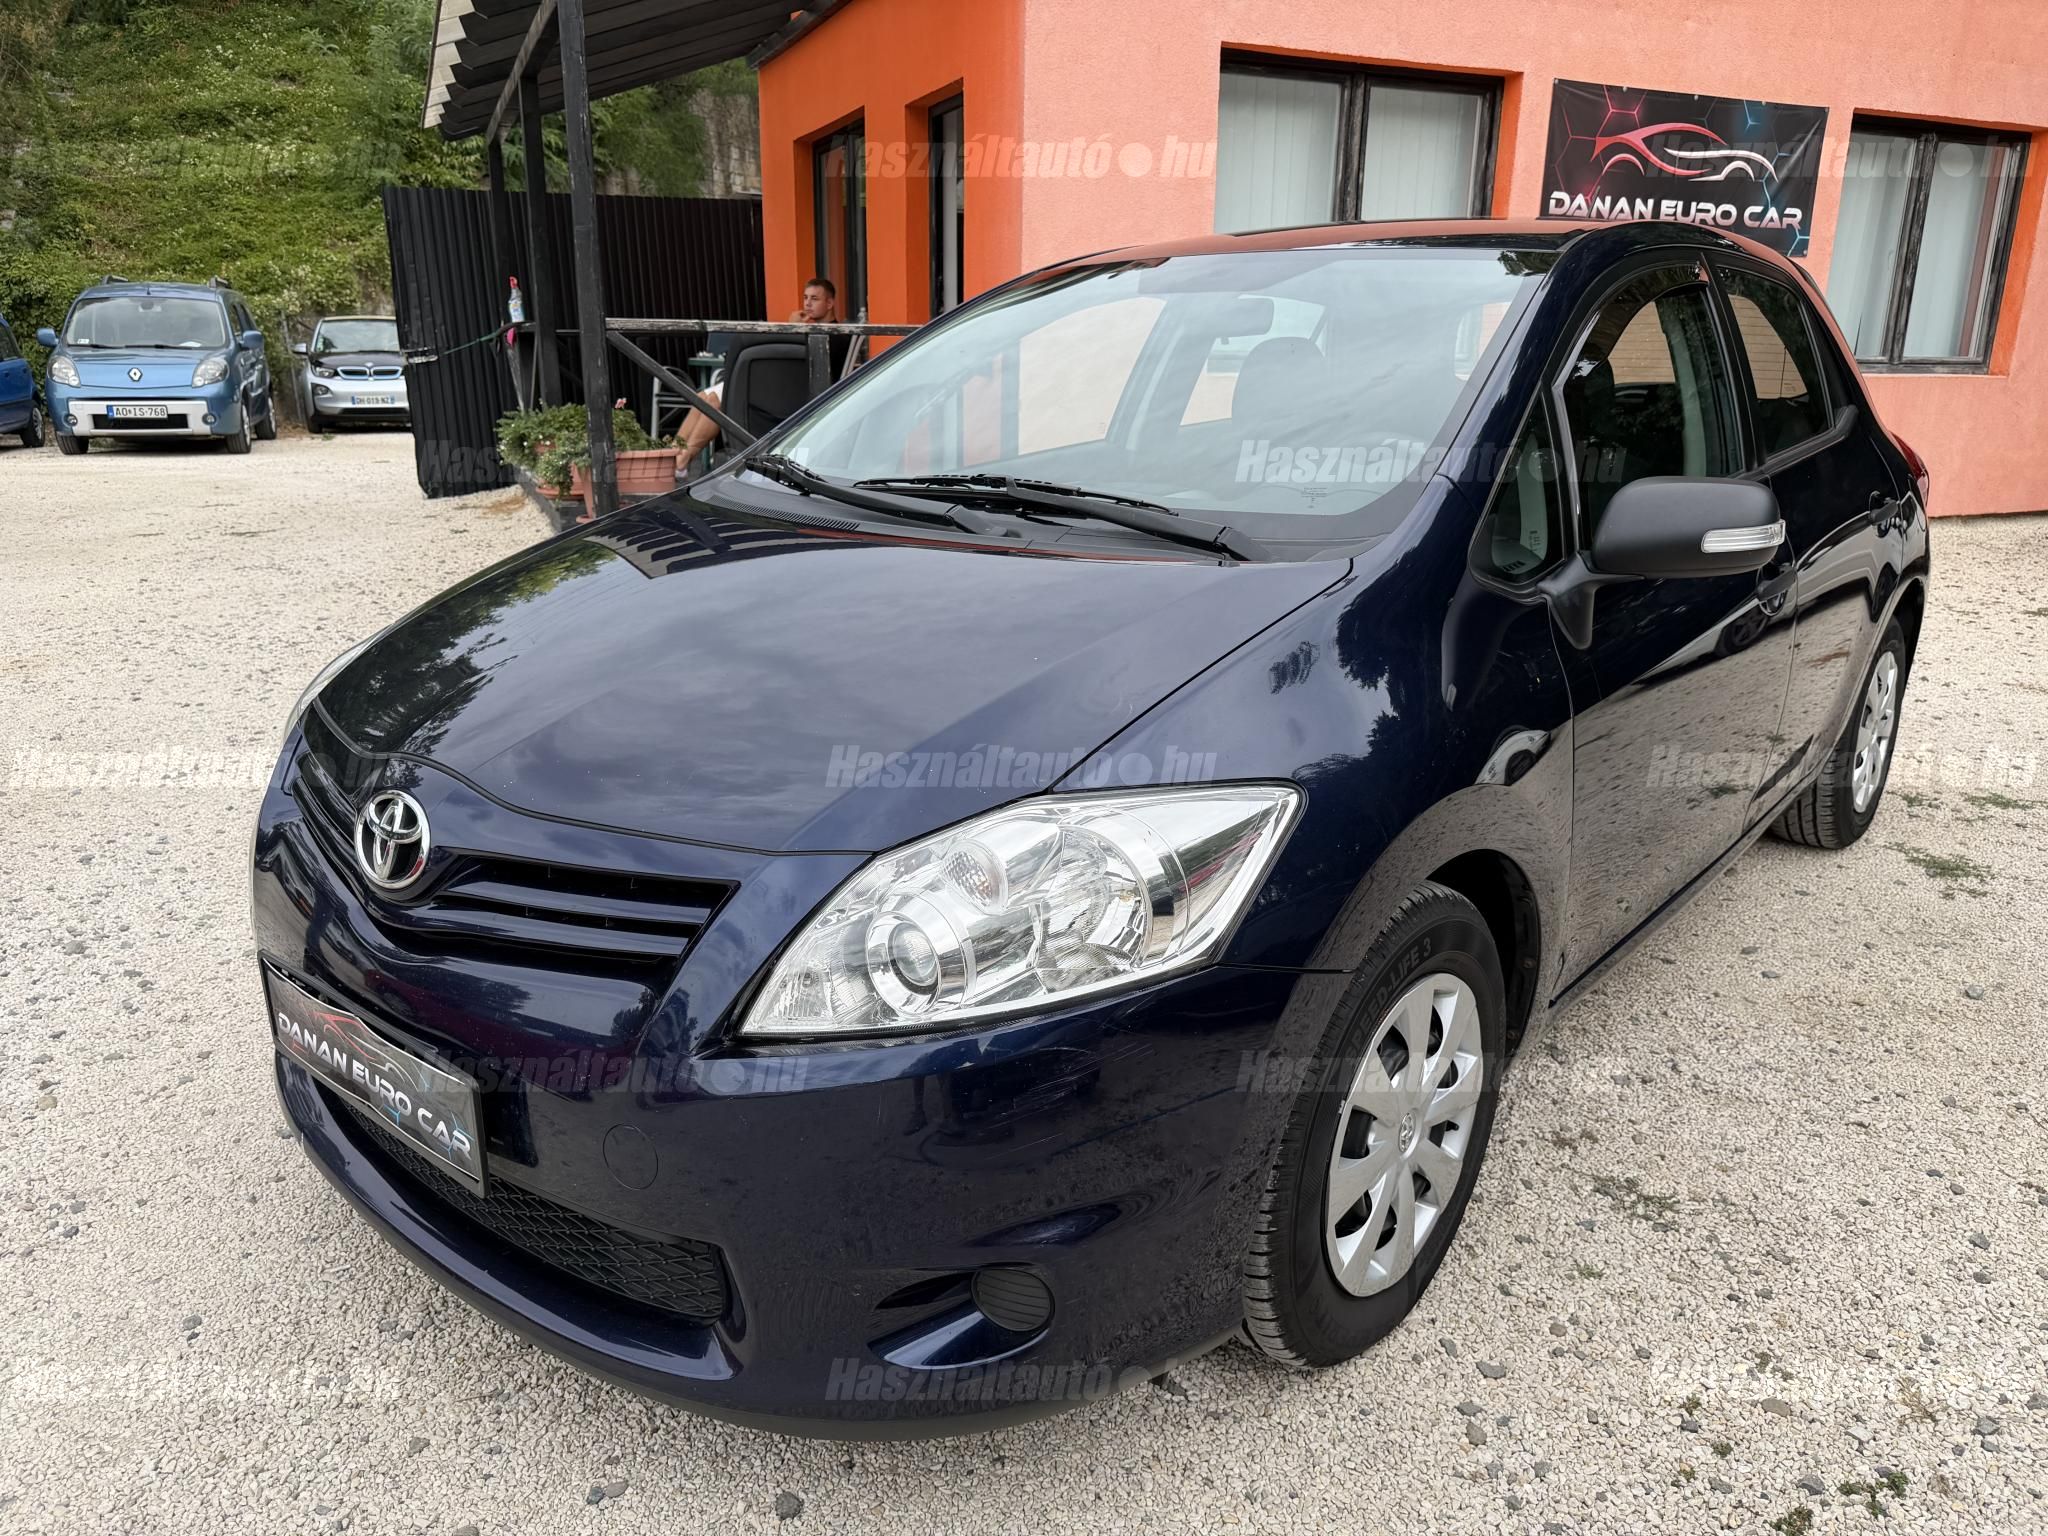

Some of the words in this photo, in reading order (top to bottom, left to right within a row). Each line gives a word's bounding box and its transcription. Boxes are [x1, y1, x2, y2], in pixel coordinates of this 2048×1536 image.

[1548, 191, 1654, 220] DANAN
[1659, 199, 1738, 226] EURO
[1743, 205, 1803, 229] CAR
[278, 1011, 347, 1074] DANAN
[352, 1059, 412, 1117] EURO
[417, 1107, 472, 1161] CAR
